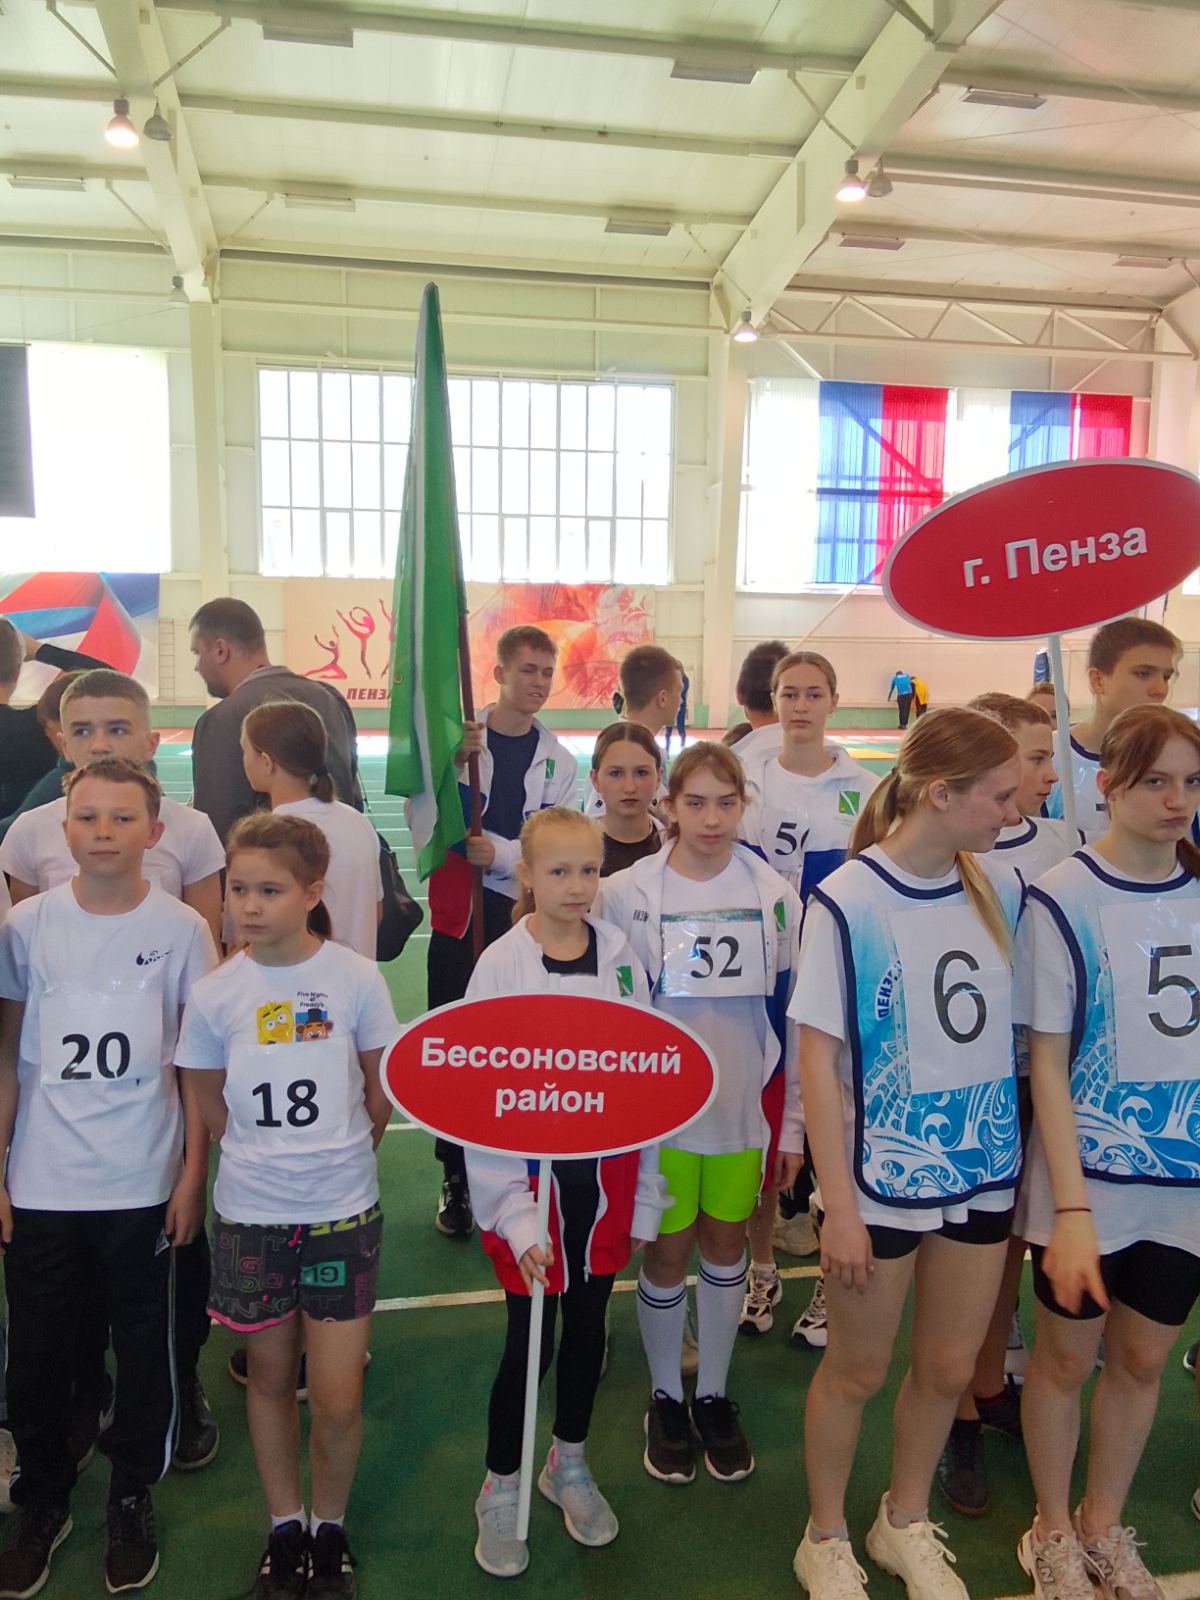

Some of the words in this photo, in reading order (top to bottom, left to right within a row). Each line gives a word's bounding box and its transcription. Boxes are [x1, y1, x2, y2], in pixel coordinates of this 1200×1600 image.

[963, 558, 991, 588] г.
[1004, 526, 1148, 579] Пенза
[690, 935, 742, 979] 52
[934, 949, 987, 1044] 6
[1147, 944, 1200, 1038] 5
[61, 1031, 131, 1080] 20
[421, 1037, 682, 1074] Бессоновский
[252, 1078, 320, 1128] 18
[495, 1082, 605, 1118] район
